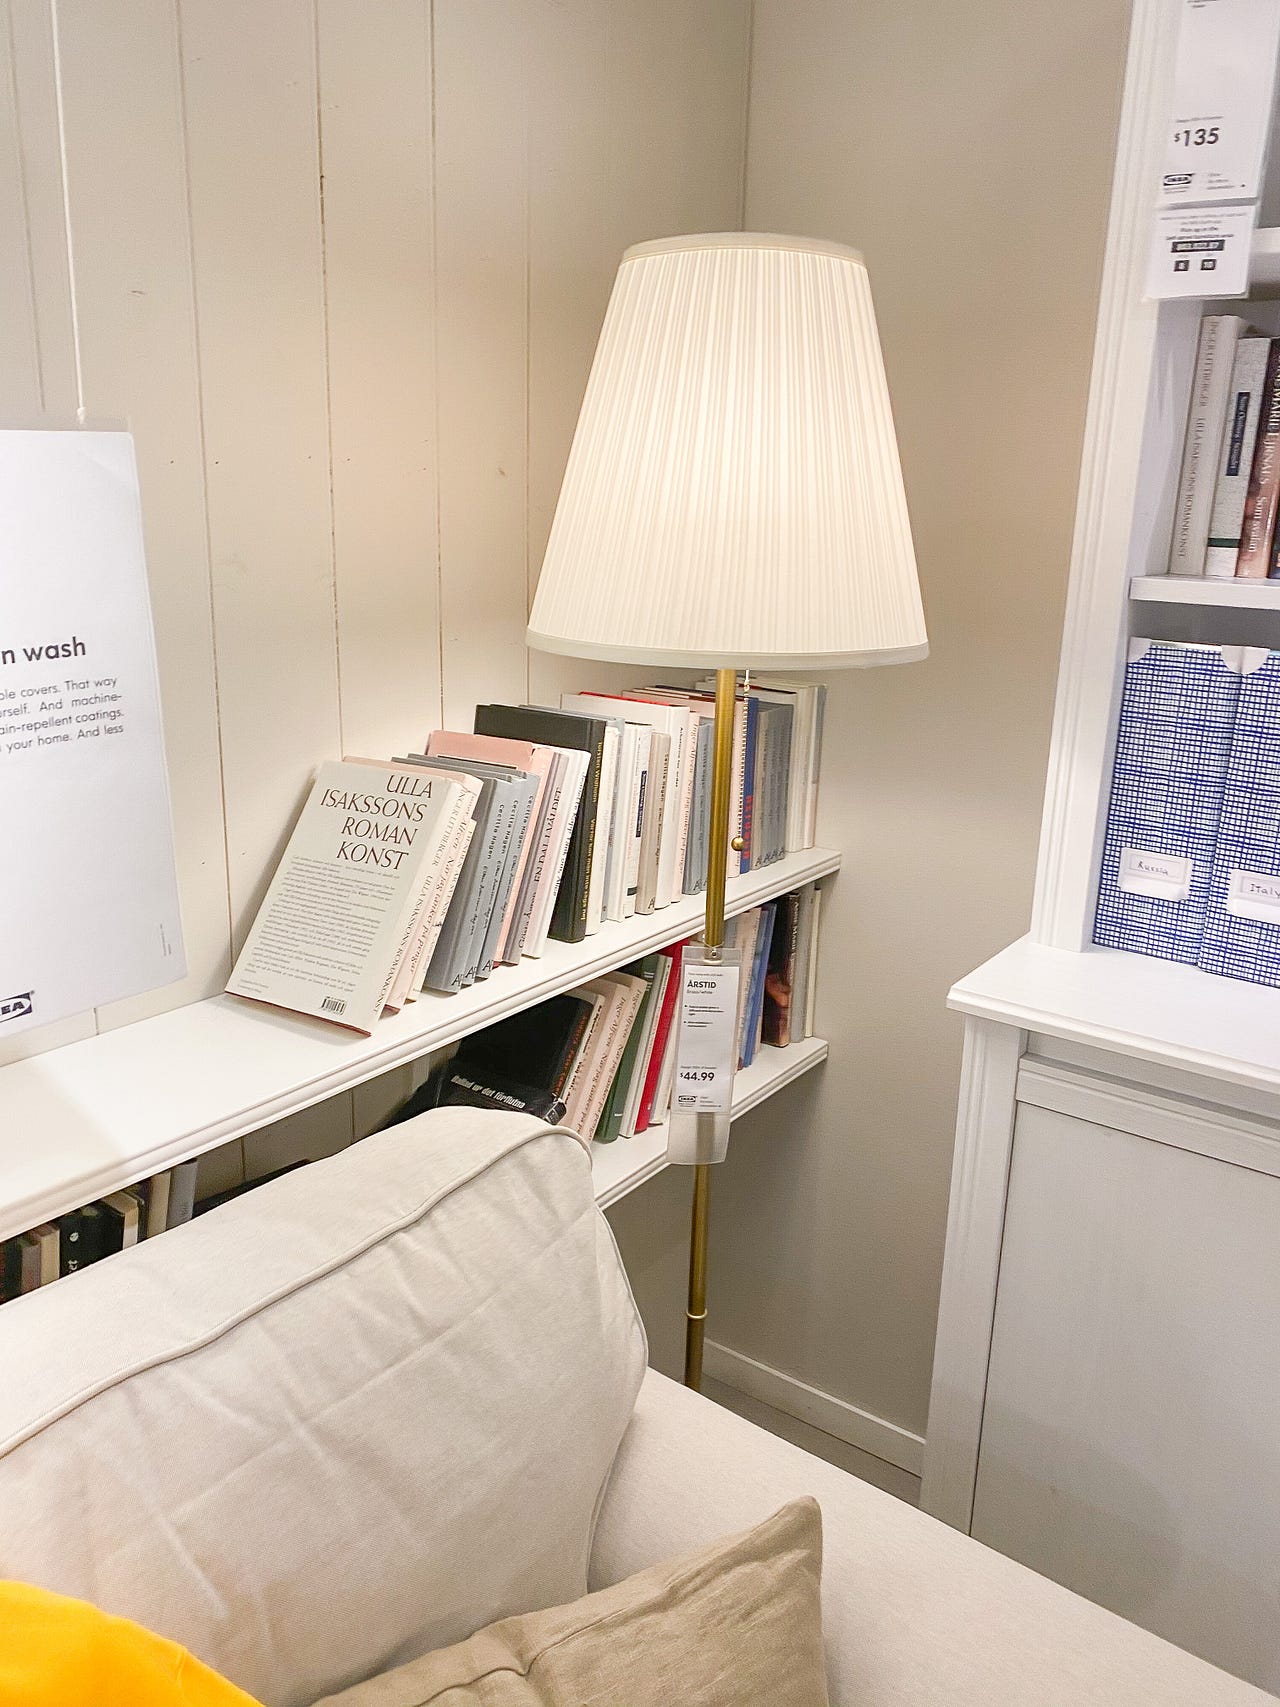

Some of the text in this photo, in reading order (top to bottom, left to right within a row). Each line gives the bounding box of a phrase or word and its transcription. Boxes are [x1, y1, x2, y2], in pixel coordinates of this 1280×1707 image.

[1174, 127, 1220, 147] $135
[23, 636, 86, 661] wash
[21, 684, 61, 697] covers.
[64, 680, 89, 690] That
[94, 678, 117, 688] way
[39, 699, 63, 712] And
[71, 693, 122, 707] machine-
[75, 709, 124, 723] coatings.
[6, 725, 123, 754] your home. And less
[386, 773, 434, 799] ULLA
[321, 788, 429, 822] ISAKSSONS
[492, 803, 504, 833] Cecilia
[506, 799, 518, 828] Cecilia
[341, 819, 419, 847] ROMAN
[515, 795, 533, 849] Cecilia Hagen
[484, 834, 497, 860] Hagen
[499, 829, 511, 855] Hagen
[336, 841, 409, 870] KONST
[687, 979, 717, 988] ÅRSTID
[613, 996, 627, 1018] Inger
[680, 1072, 714, 1081] $44.99
